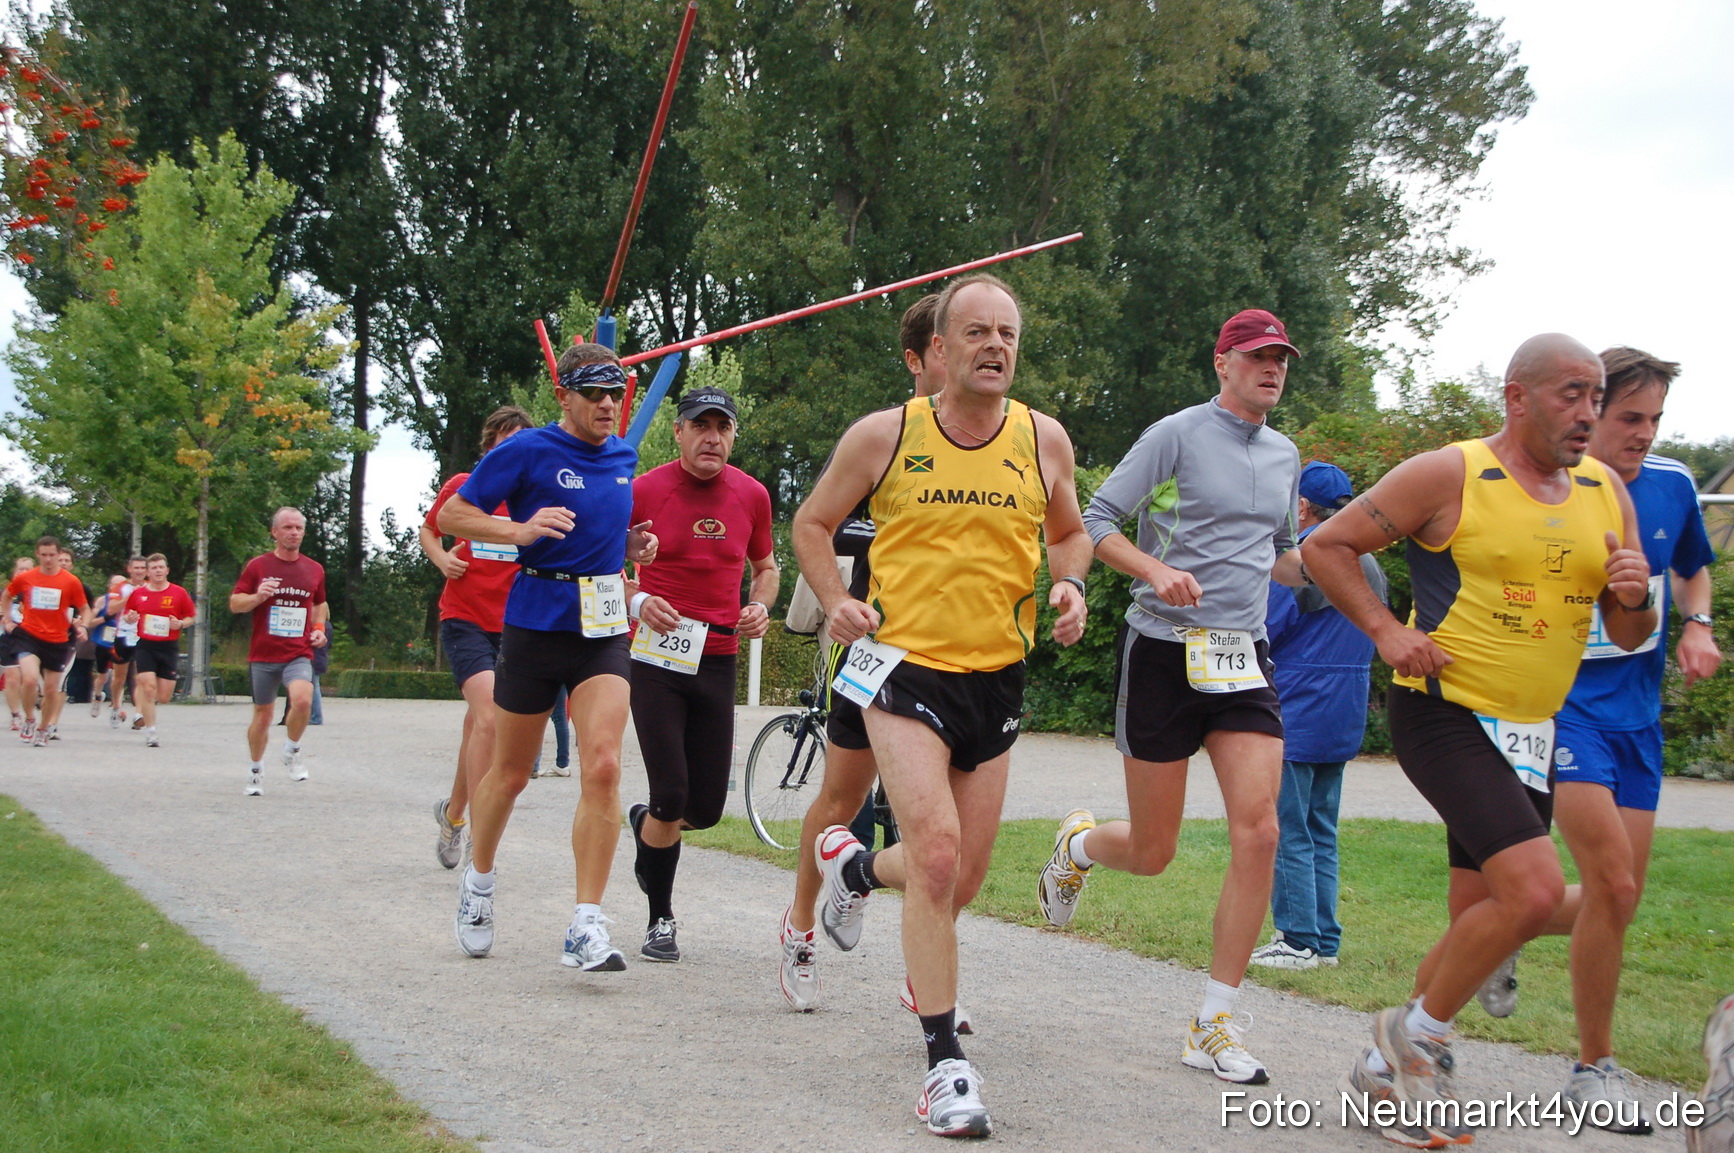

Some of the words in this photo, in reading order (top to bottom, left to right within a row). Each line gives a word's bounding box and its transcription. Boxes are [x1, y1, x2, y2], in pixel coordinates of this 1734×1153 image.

[917, 489, 1018, 509] JAMAICA
[596, 582, 615, 593] Klaus
[1503, 587, 1537, 602] Seidl
[603, 599, 622, 617] 301
[281, 618, 303, 627] 2970
[658, 634, 692, 654] 239
[1210, 632, 1241, 646] Stefan
[1190, 651, 1196, 661] B
[1214, 652, 1246, 671] 713
